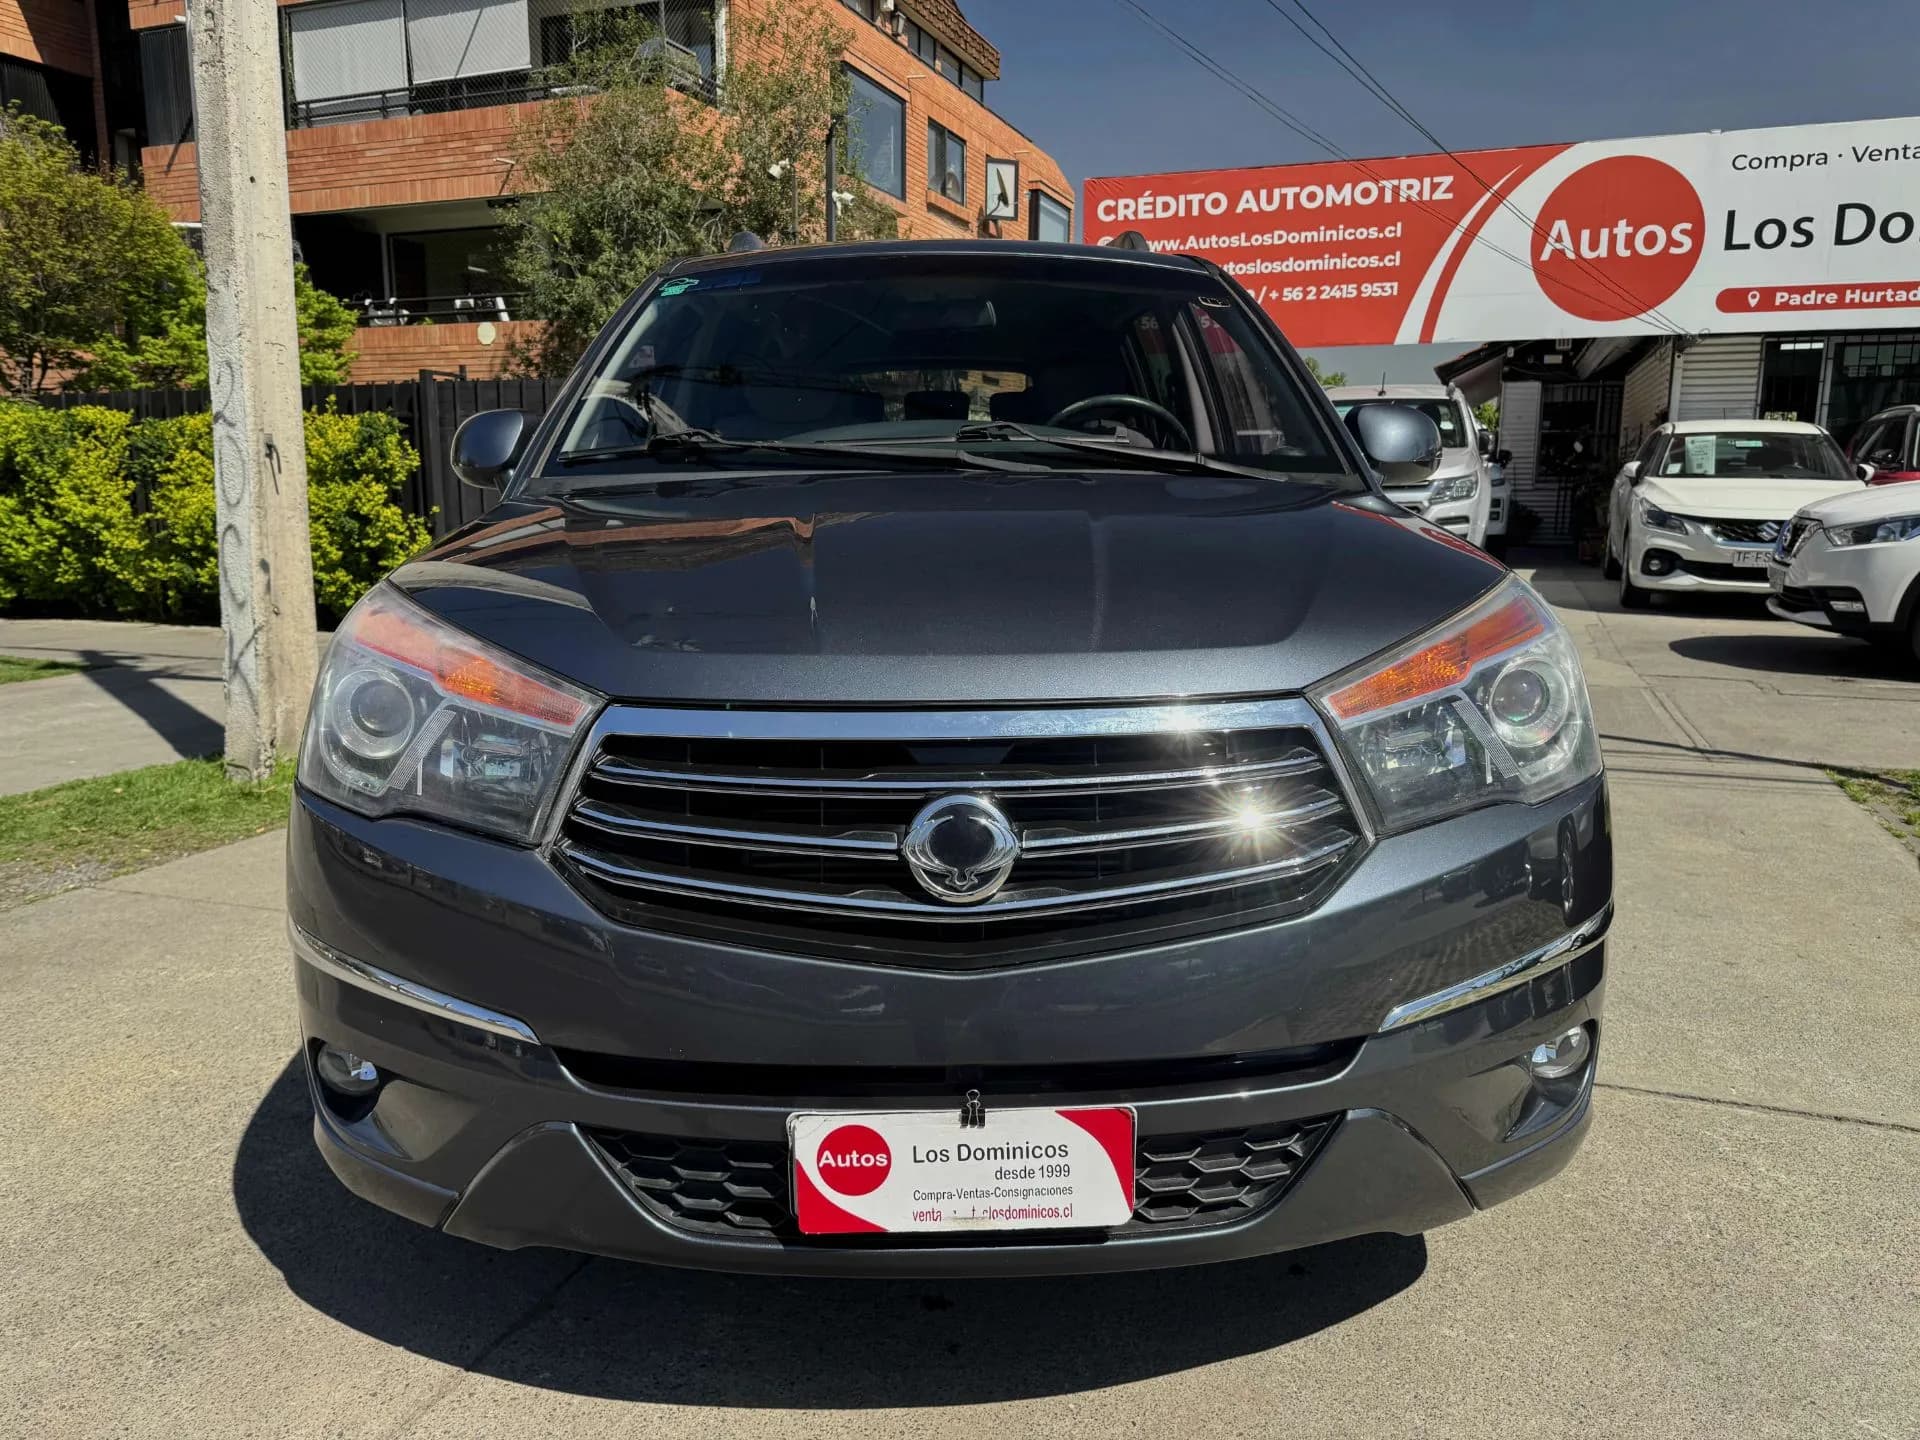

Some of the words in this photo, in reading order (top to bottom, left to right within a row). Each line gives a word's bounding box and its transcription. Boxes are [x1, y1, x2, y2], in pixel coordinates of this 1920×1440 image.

[1732, 149, 1828, 172] Compra
[1097, 190, 1228, 222] CRÉDITO
[1236, 175, 1454, 214] AUTOMOTRIZ
[1146, 222, 1402, 252] ww.AutosLosDominicos.cl
[1724, 209, 1815, 251] Los
[1834, 202, 1920, 246] Do
[1540, 219, 1694, 262] Autos
[1282, 286, 1304, 302] 56
[1306, 285, 1317, 300] 2
[1320, 283, 1358, 299] 2415
[1361, 282, 1399, 297] 9531
[1774, 290, 1838, 306] Padre
[818, 1149, 889, 1168] Autos
[913, 1145, 950, 1164] Los
[957, 1141, 1069, 1162] Dominicos
[994, 1165, 1036, 1181] desde
[1038, 1163, 1071, 1179] 1999
